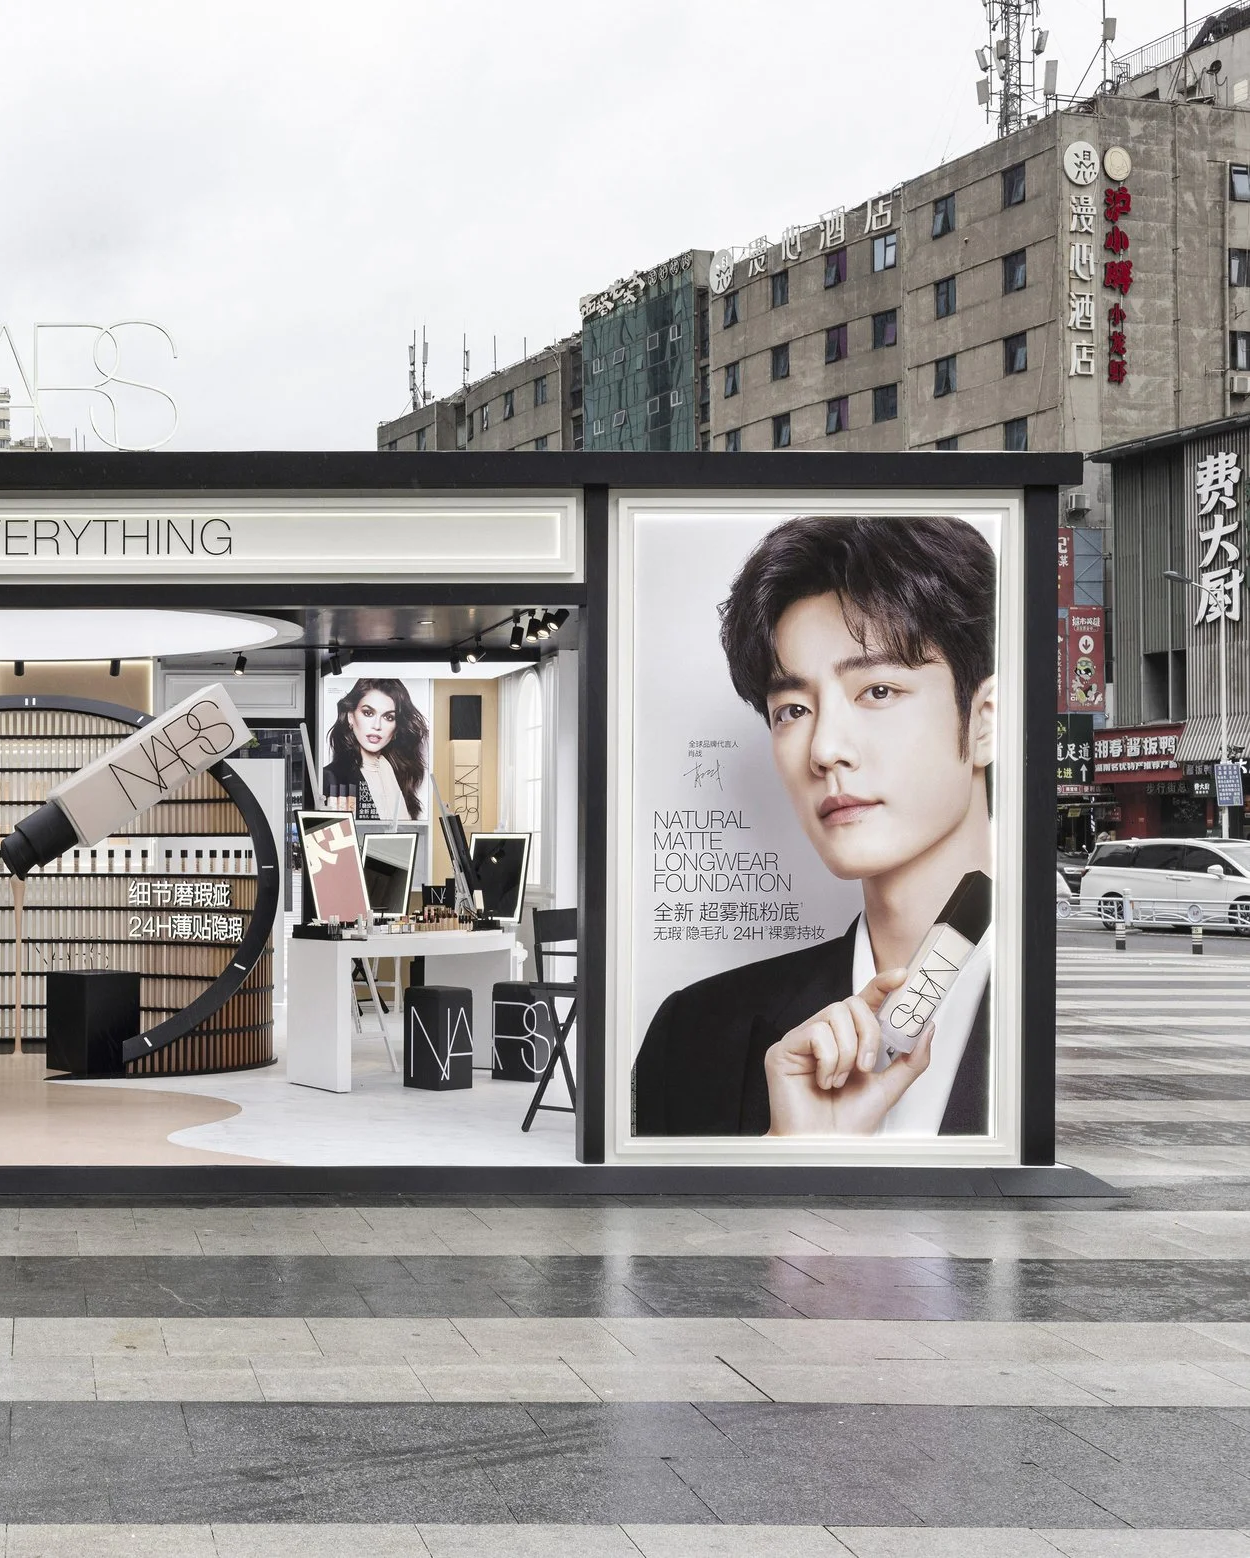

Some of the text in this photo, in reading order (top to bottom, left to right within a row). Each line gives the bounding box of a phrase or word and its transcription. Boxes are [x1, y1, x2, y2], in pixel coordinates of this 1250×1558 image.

[748, 191, 894, 278] 漫心酒店
[1068, 195, 1097, 377] 漫心酒店
[1194, 452, 1244, 627] 费大厨
[109, 700, 235, 811] NARS
[688, 739, 739, 749] 全球品牌代言人
[688, 750, 703, 758] 肖战
[454, 765, 480, 825] NARS
[653, 810, 751, 830] NATURAL
[653, 831, 724, 851] MATTE
[653, 852, 780, 872] LONGWEAR
[128, 880, 232, 908] 细节磨瑕疵
[653, 873, 793, 893] FOUNDATION
[653, 902, 694, 922] 全新
[128, 912, 245, 943] 24H薄贴隐瑕
[890, 949, 960, 1038] NARS
